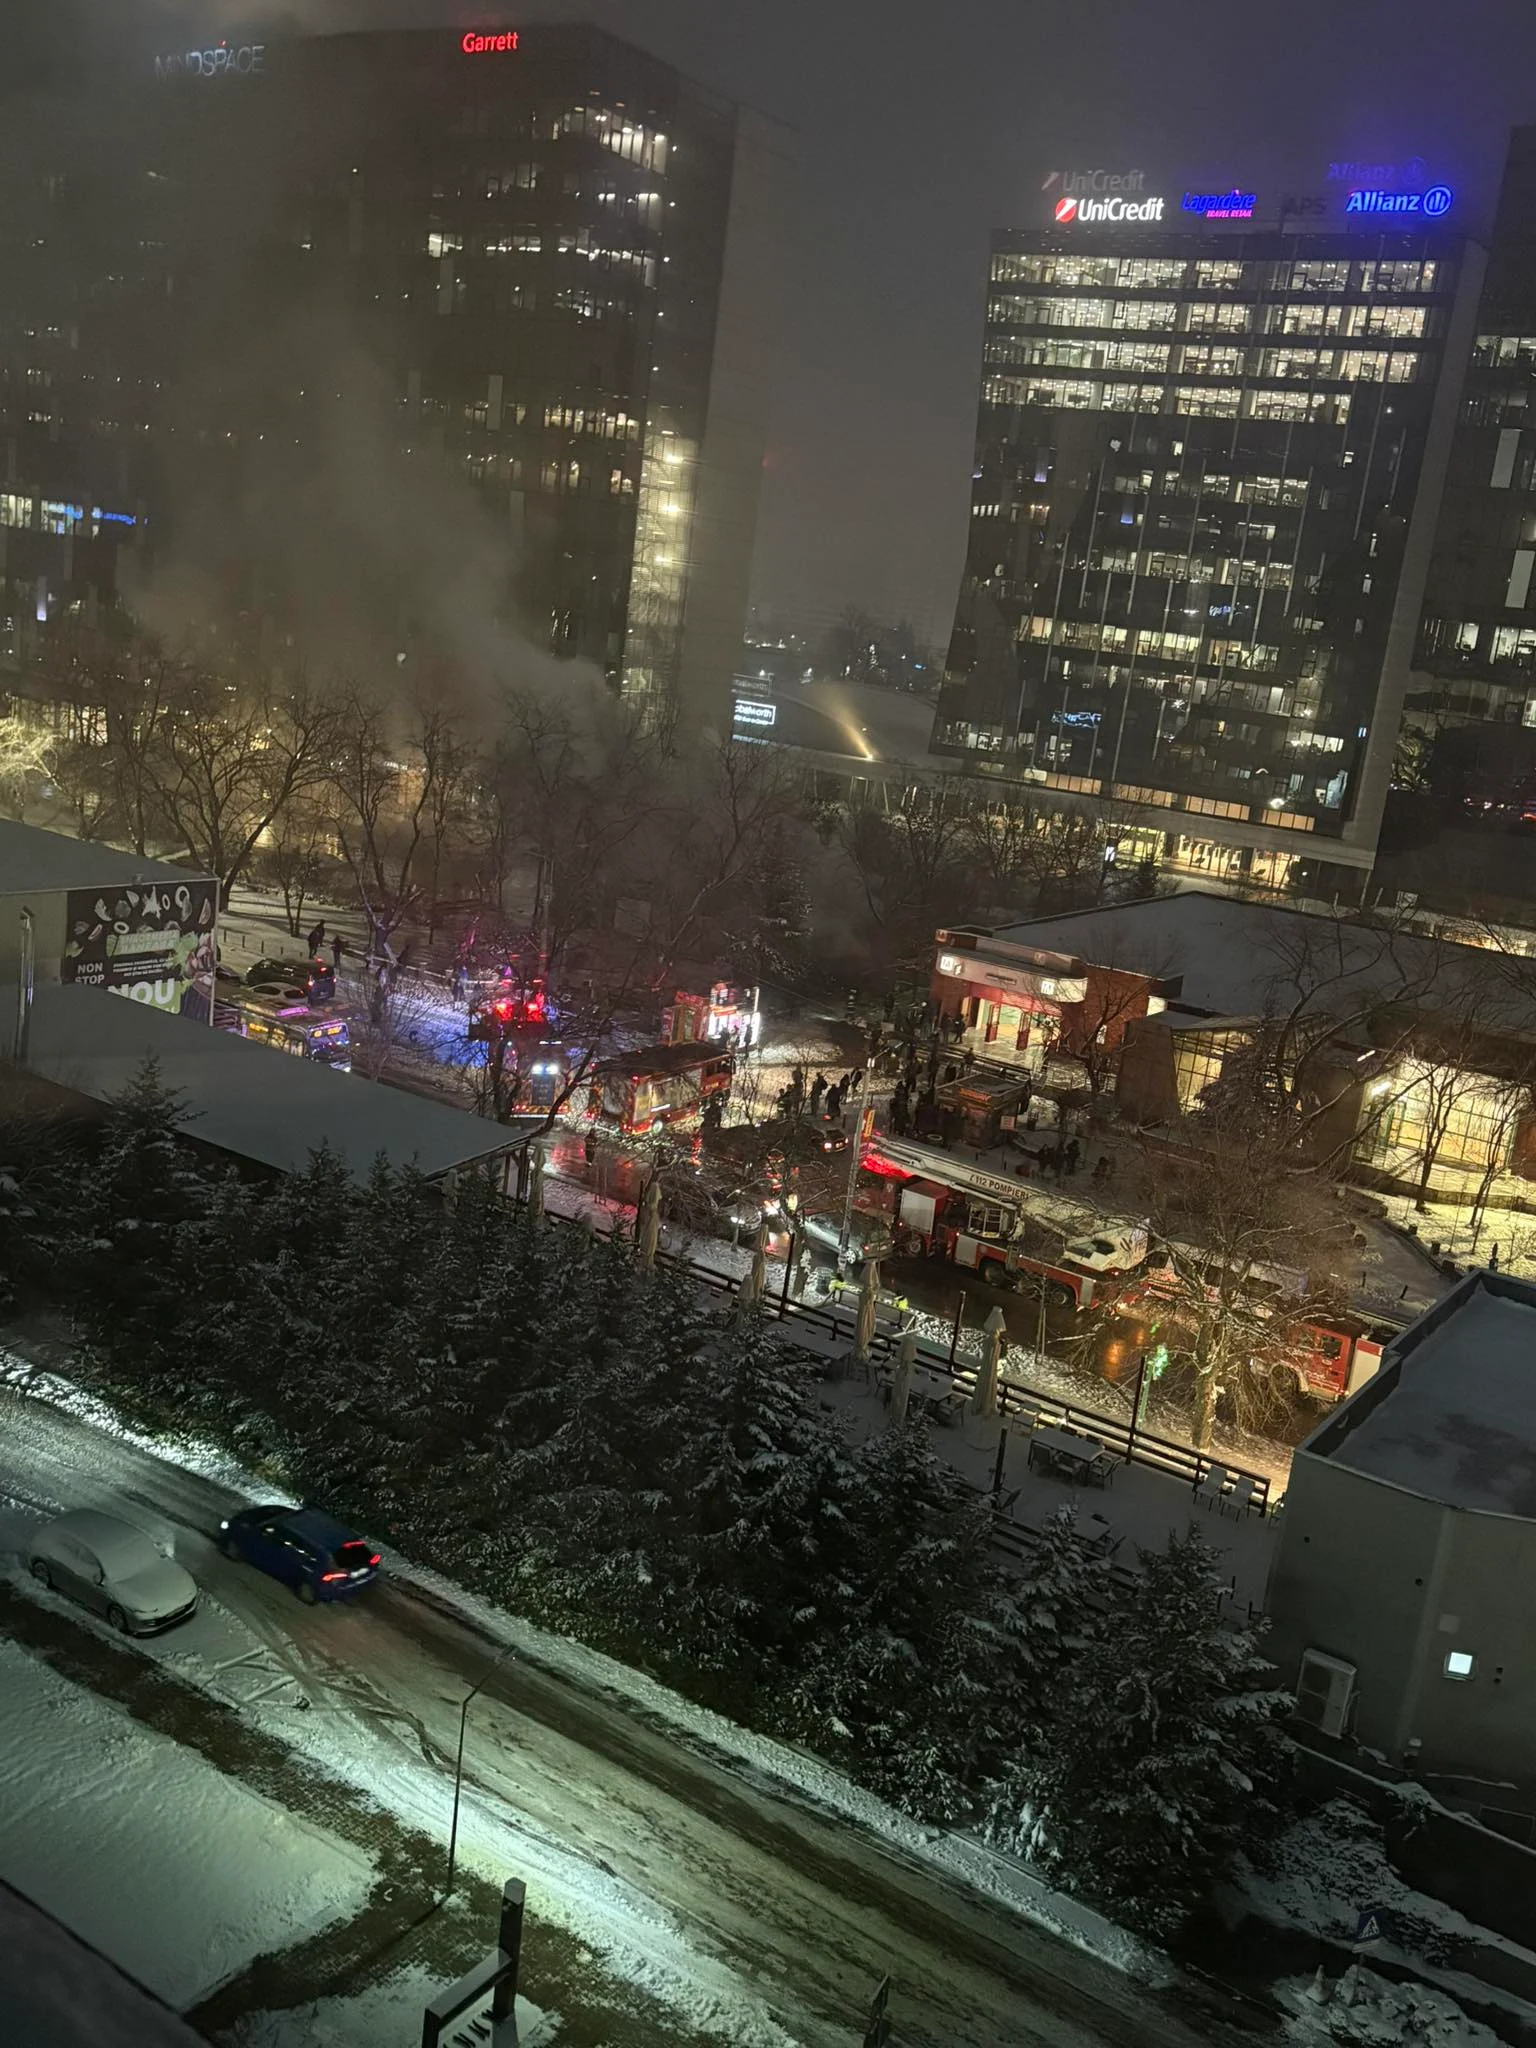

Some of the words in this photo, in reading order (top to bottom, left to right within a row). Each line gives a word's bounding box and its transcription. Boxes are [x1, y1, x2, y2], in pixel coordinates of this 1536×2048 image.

[463, 32, 518, 53] Garrett
[1063, 169, 1145, 192] UniCredit
[1078, 197, 1165, 221] UniCredit
[1346, 191, 1420, 212] Allianz
[77, 962, 103, 974] NON
[975, 1175, 987, 1187] 112
